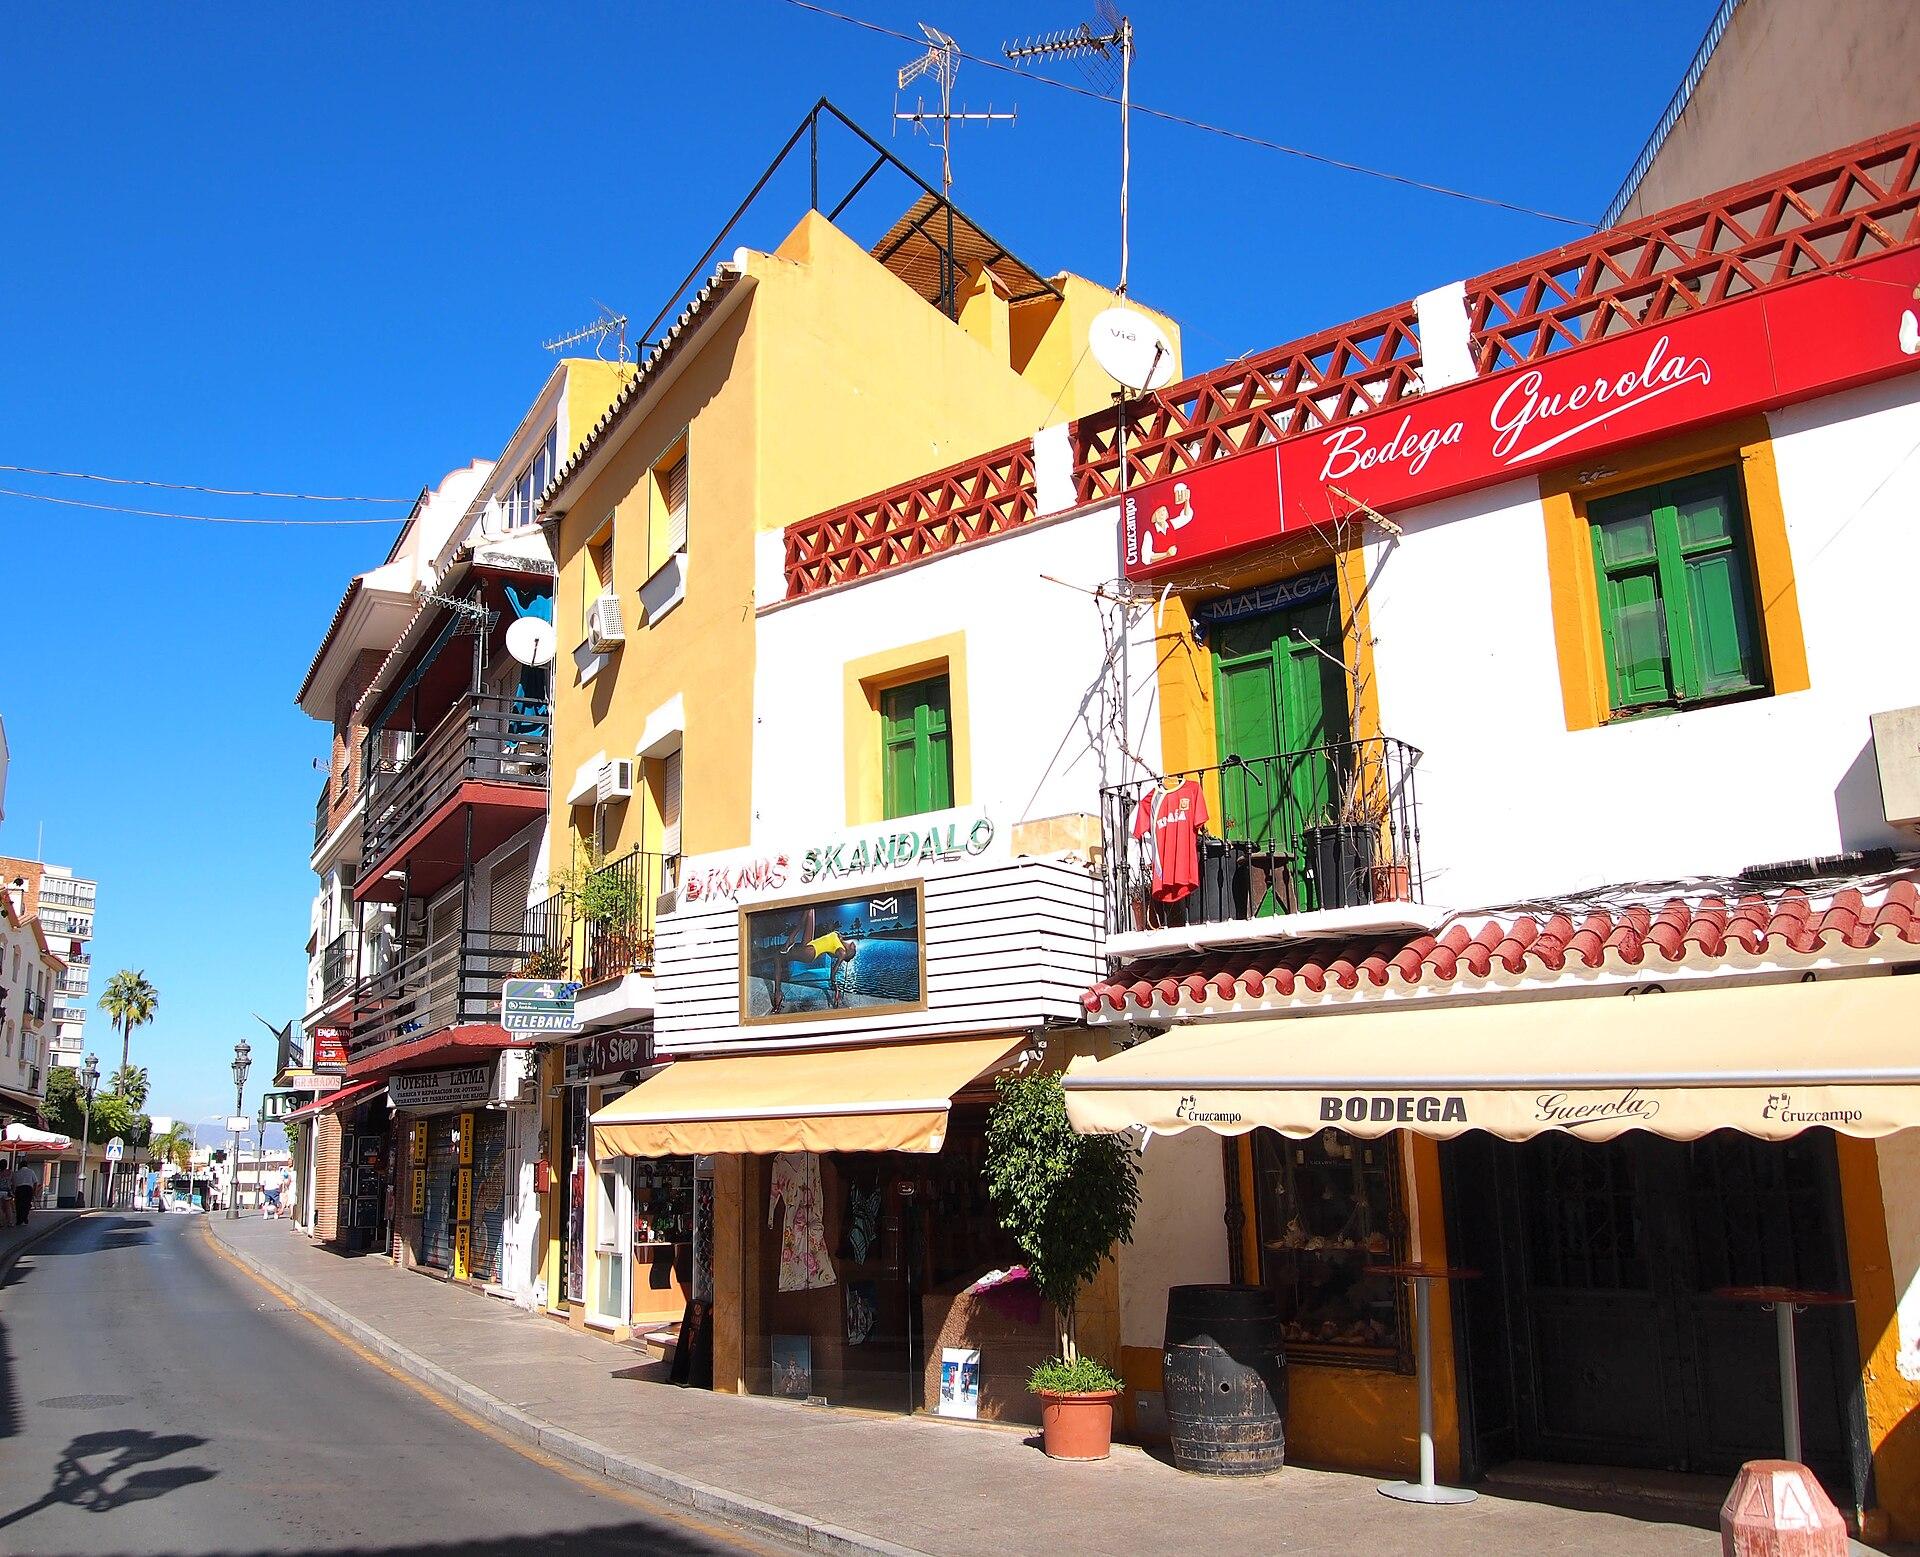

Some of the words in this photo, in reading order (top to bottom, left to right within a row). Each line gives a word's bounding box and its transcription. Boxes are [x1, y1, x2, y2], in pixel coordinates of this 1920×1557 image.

[1319, 415, 1464, 481] Bodega
[1490, 335, 1710, 464] Guerola
[1125, 497, 1138, 566] Cruzcampo
[1212, 571, 1330, 619] MALAGA
[800, 818, 994, 883] SKANDALO
[609, 1038, 639, 1063] Step
[294, 1076, 340, 1088] GRABADOS
[396, 1073, 439, 1091] JOYERIA
[449, 1069, 486, 1086] LAYMA
[1188, 1110, 1242, 1124] Cruzcampo
[1319, 1097, 1468, 1123] BODEGA
[1535, 1087, 1658, 1126] Guerola
[1781, 1107, 1863, 1124] Cruzcampo
